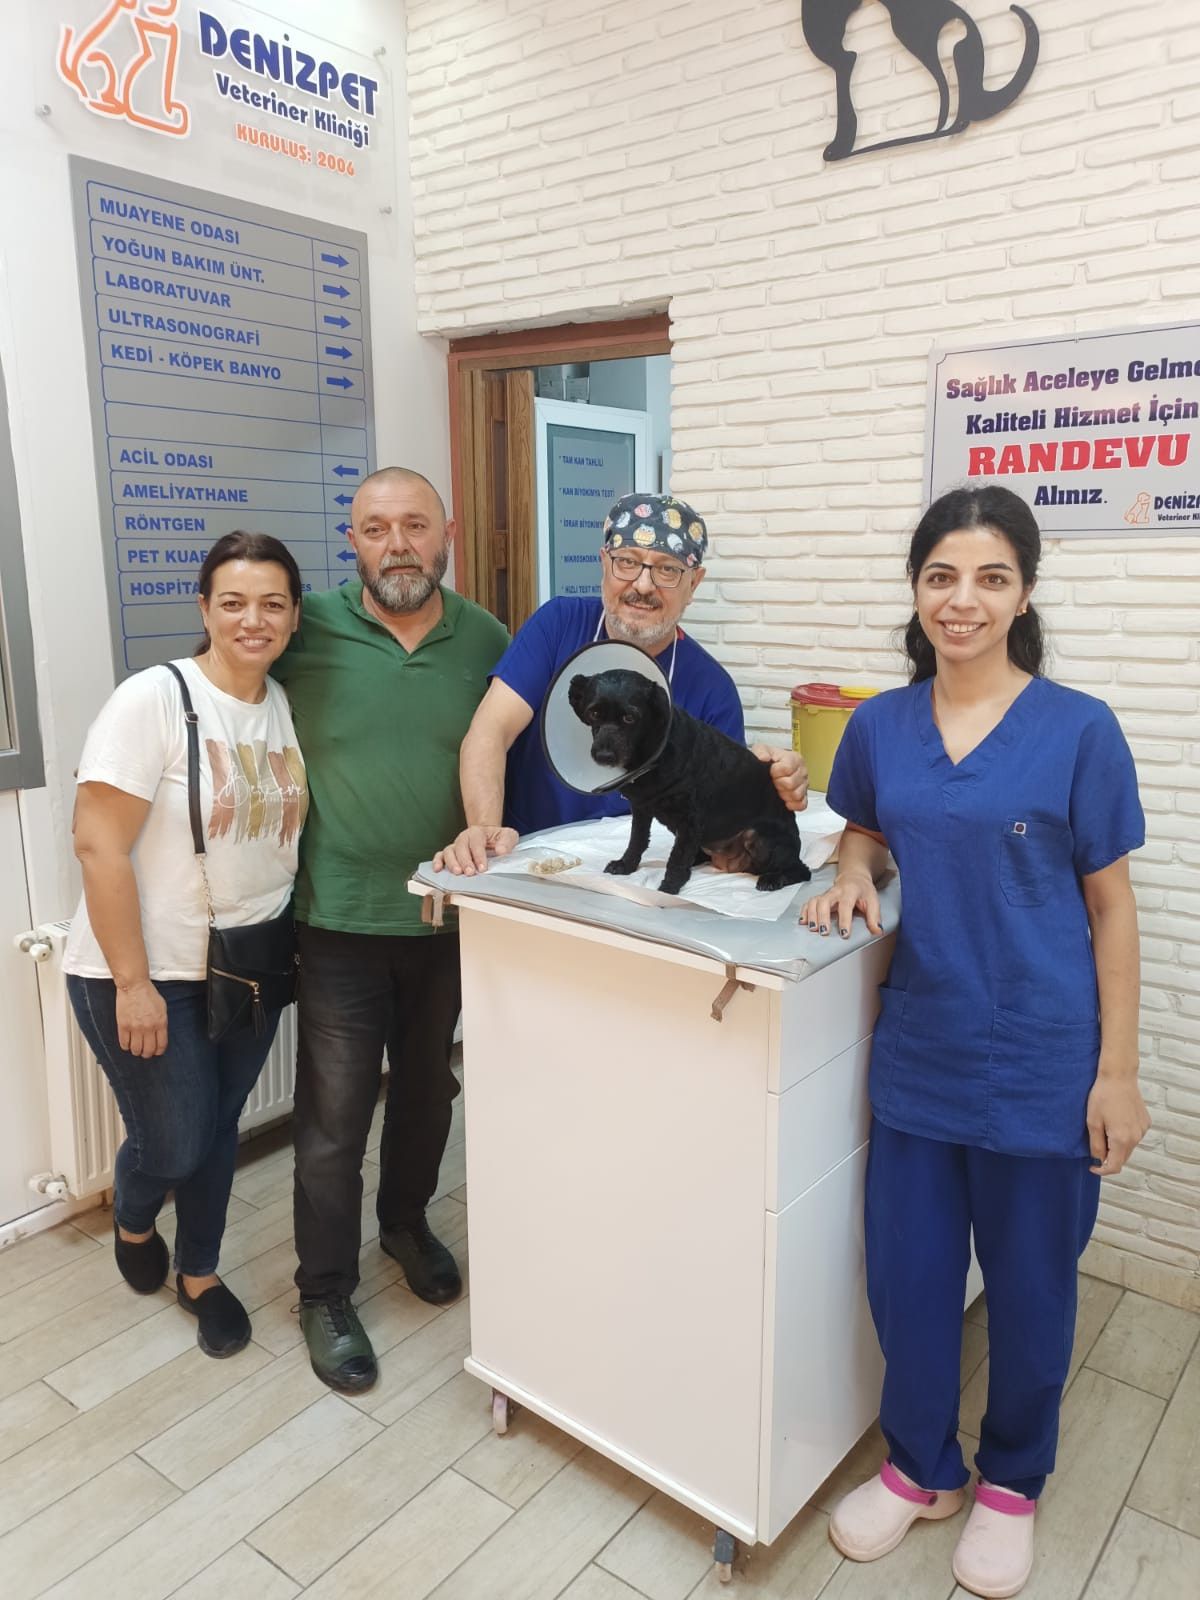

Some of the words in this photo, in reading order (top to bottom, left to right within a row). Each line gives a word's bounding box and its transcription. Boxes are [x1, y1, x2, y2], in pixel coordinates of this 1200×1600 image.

[199, 11, 378, 115] DENİZPET
[216, 73, 308, 124] Veteriner
[314, 110, 369, 147] Kliniği
[317, 151, 355, 176] 2006
[100, 198, 185, 232] MUAYENE
[191, 220, 240, 245] ODASI
[102, 235, 166, 263] YOĞUN
[172, 250, 225, 275] BAKIM
[230, 260, 265, 283] ÜNT.
[105, 270, 231, 308] LABORATUVAR
[108, 308, 260, 346] ULTRASONOGRAFİ
[111, 343, 153, 363] KEDİ
[169, 351, 224, 373] KÖPEK
[230, 361, 281, 380] BANYO
[946, 374, 1016, 402] Sağlık
[1023, 367, 1119, 391] Aceleye
[966, 409, 1046, 435] Kaliteli
[1054, 402, 1140, 429] Hizmet
[1148, 394, 1199, 426] İçin
[120, 448, 158, 465] ACİL
[164, 453, 213, 468] ODASI
[967, 433, 1191, 477] RANDEVU
[123, 483, 248, 502] AMELİYATHANE
[1034, 485, 1108, 505] Alınız.
[125, 514, 205, 531] RÖNTGEN
[1158, 513, 1190, 521] Veteriner
[128, 550, 159, 563] PET
[165, 550, 208, 563] KUAF
[130, 578, 200, 595] HOSPİTA
